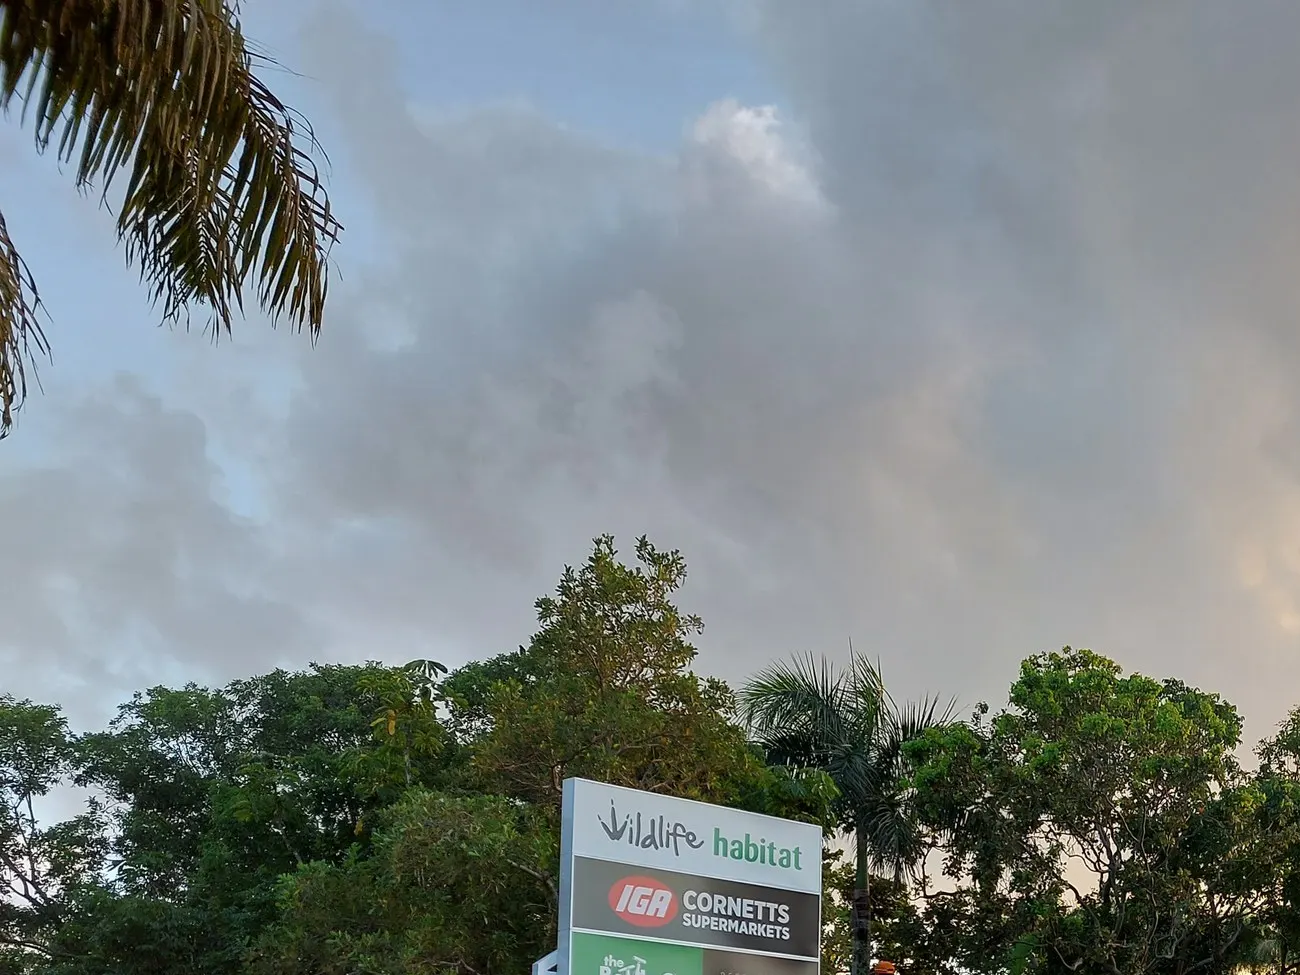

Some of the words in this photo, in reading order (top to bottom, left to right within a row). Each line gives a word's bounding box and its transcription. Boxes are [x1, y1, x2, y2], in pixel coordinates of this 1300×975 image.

[597, 799, 705, 857] Wildlife
[713, 827, 803, 870] habitat
[615, 884, 673, 918] IGA
[683, 889, 790, 924] CORNETTS
[682, 912, 790, 940] SUPERMARKETS
[603, 954, 624, 968] the
